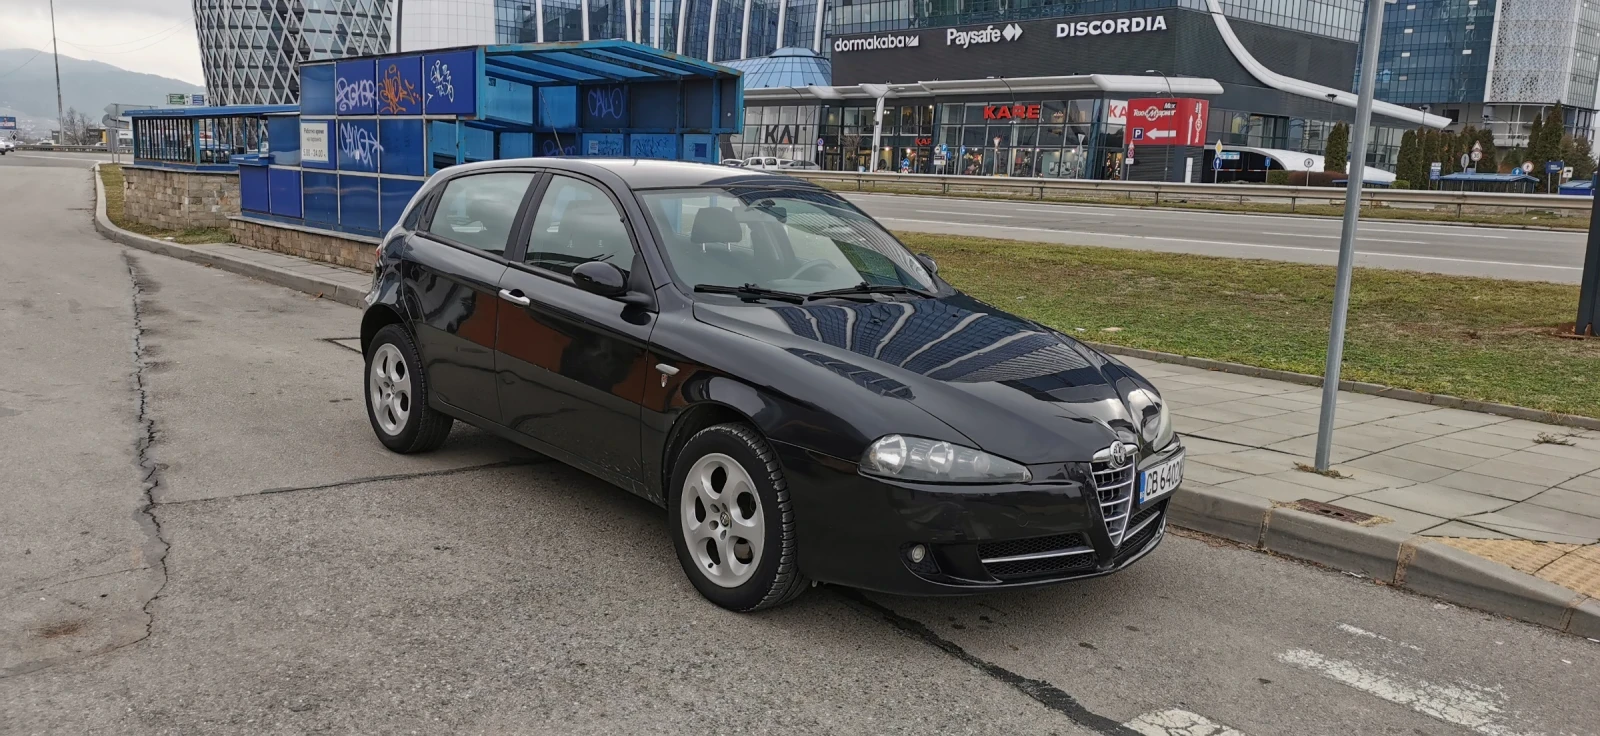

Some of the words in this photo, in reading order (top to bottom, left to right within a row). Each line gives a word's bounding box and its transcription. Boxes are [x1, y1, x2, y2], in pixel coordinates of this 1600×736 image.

[1056, 15, 1167, 38] DISCORDIA
[834, 34, 905, 52] dormakaba
[946, 25, 1001, 49] Paysafe
[983, 104, 1041, 119] KARE
[1134, 129, 1142, 138] P
[1146, 471, 1158, 496] CB
